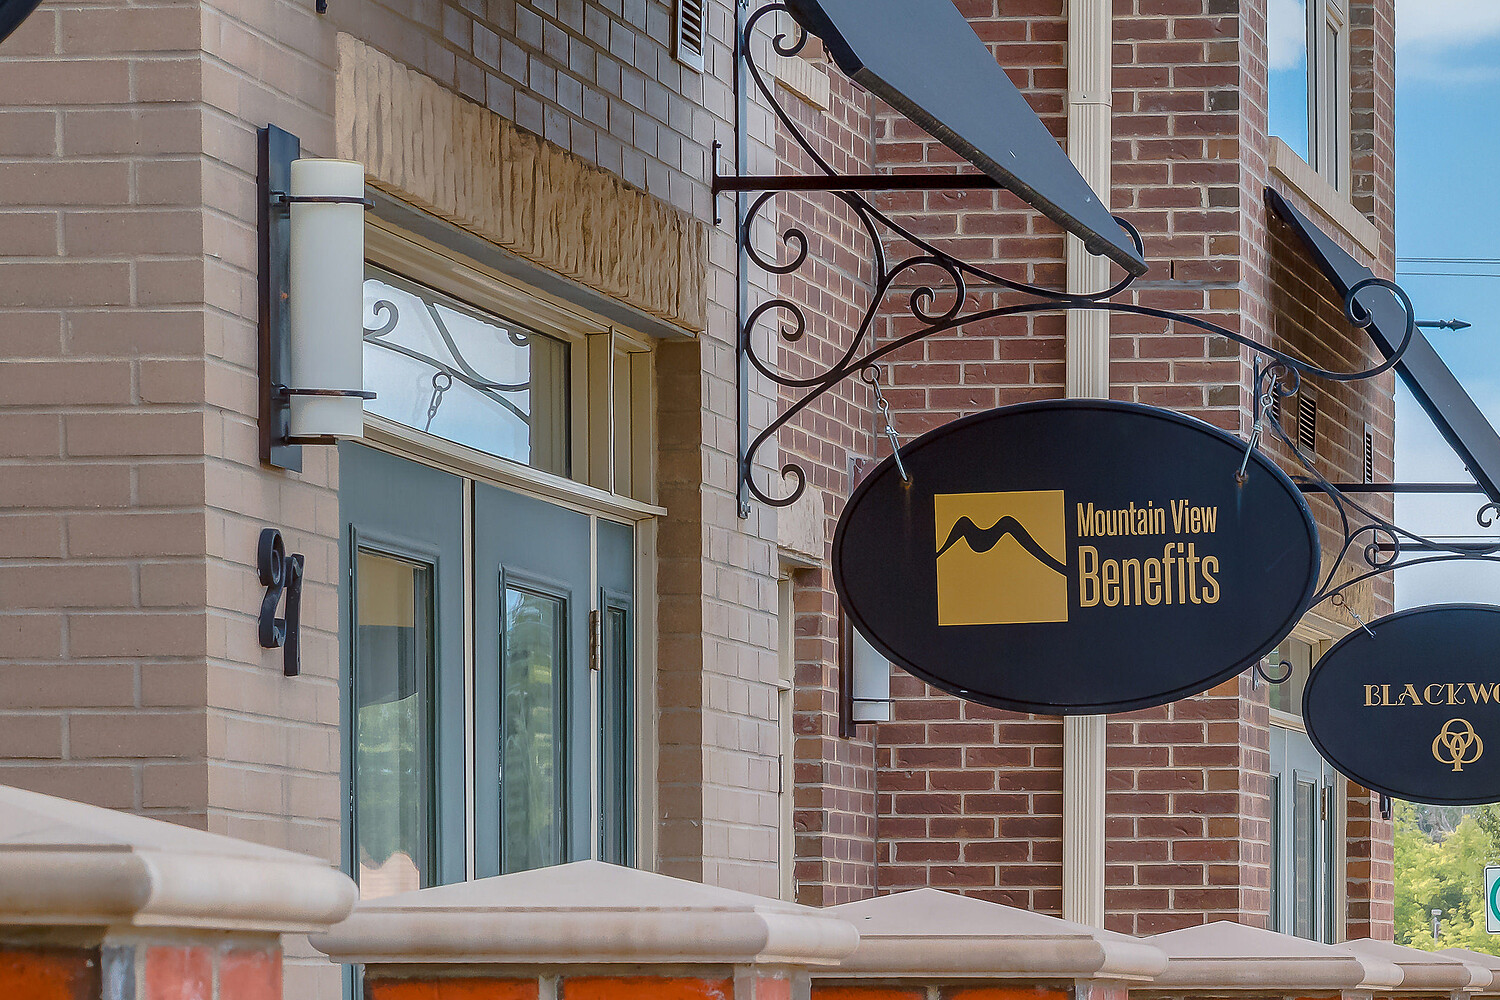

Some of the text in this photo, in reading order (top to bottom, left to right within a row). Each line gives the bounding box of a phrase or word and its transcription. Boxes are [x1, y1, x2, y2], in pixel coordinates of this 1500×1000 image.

[1077, 499, 1218, 537] Mountain View
[1078, 542, 1220, 608] Benefits
